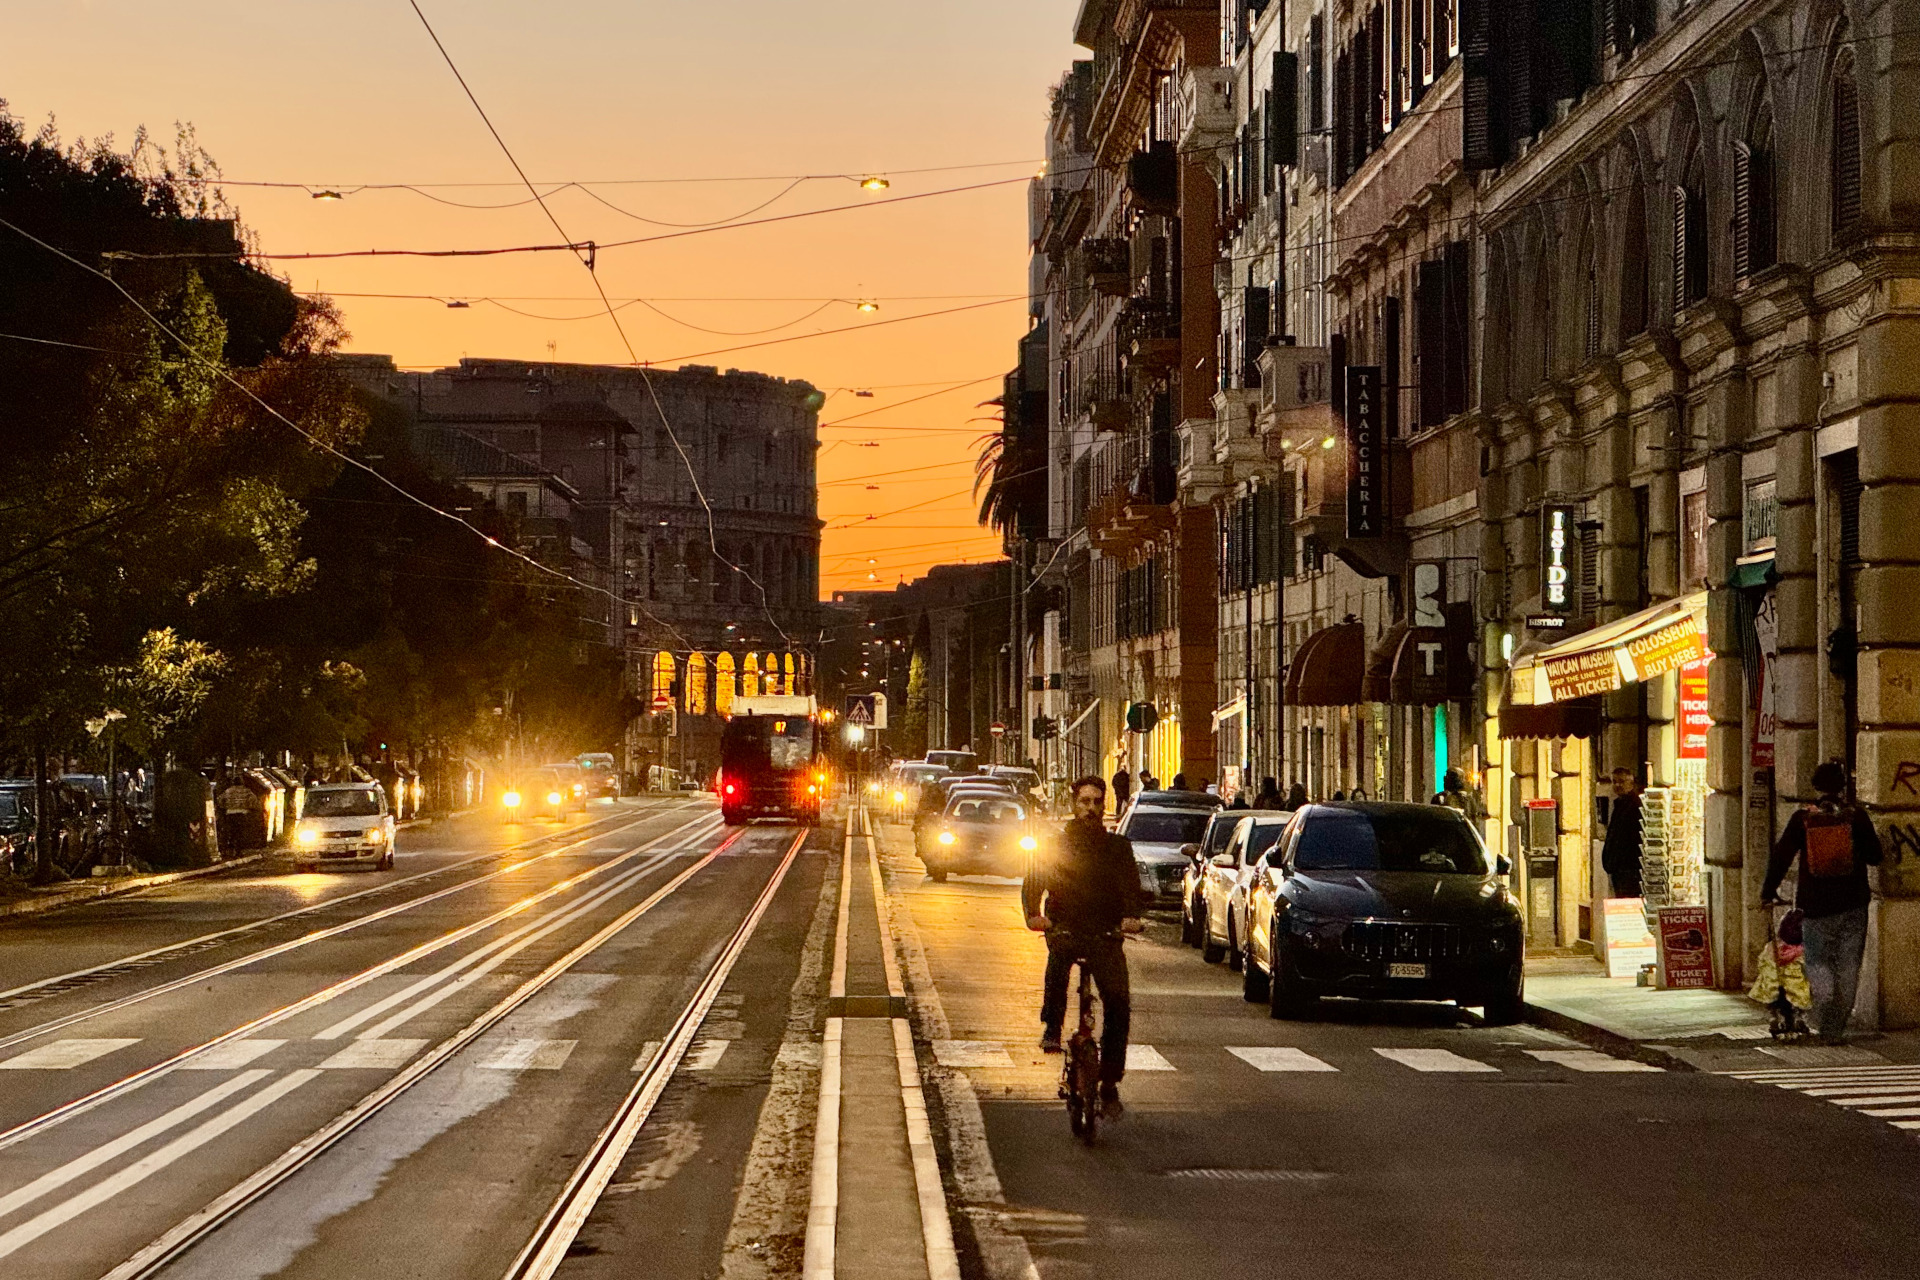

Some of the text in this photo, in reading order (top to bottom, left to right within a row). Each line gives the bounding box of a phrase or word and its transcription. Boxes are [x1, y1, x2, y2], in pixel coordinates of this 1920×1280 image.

[1358, 374, 1371, 531] TABACCHERIA
[1548, 511, 1567, 603] ISIDE
[1528, 618, 1565, 627] BISTROT
[1629, 620, 1698, 657] COLOSSEUM
[1644, 647, 1670, 662] GUIDED
[1670, 639, 1690, 654] TOUR
[1416, 642, 1442, 676] T
[1546, 649, 1615, 677] VATICAN MUSEUM
[1644, 658, 1668, 676] BUY
[1671, 646, 1699, 667] HERE
[1683, 660, 1701, 671] HOP
[1550, 677, 1565, 687] SKIP
[1566, 674, 1580, 683] THE
[1580, 671, 1596, 680] LINE
[1556, 685, 1576, 701] ALL
[1576, 675, 1620, 697] TICKETS
[1662, 915, 1704, 924] TICKET
[1669, 969, 1709, 978] TICKET
[1675, 978, 1705, 986] HERE
